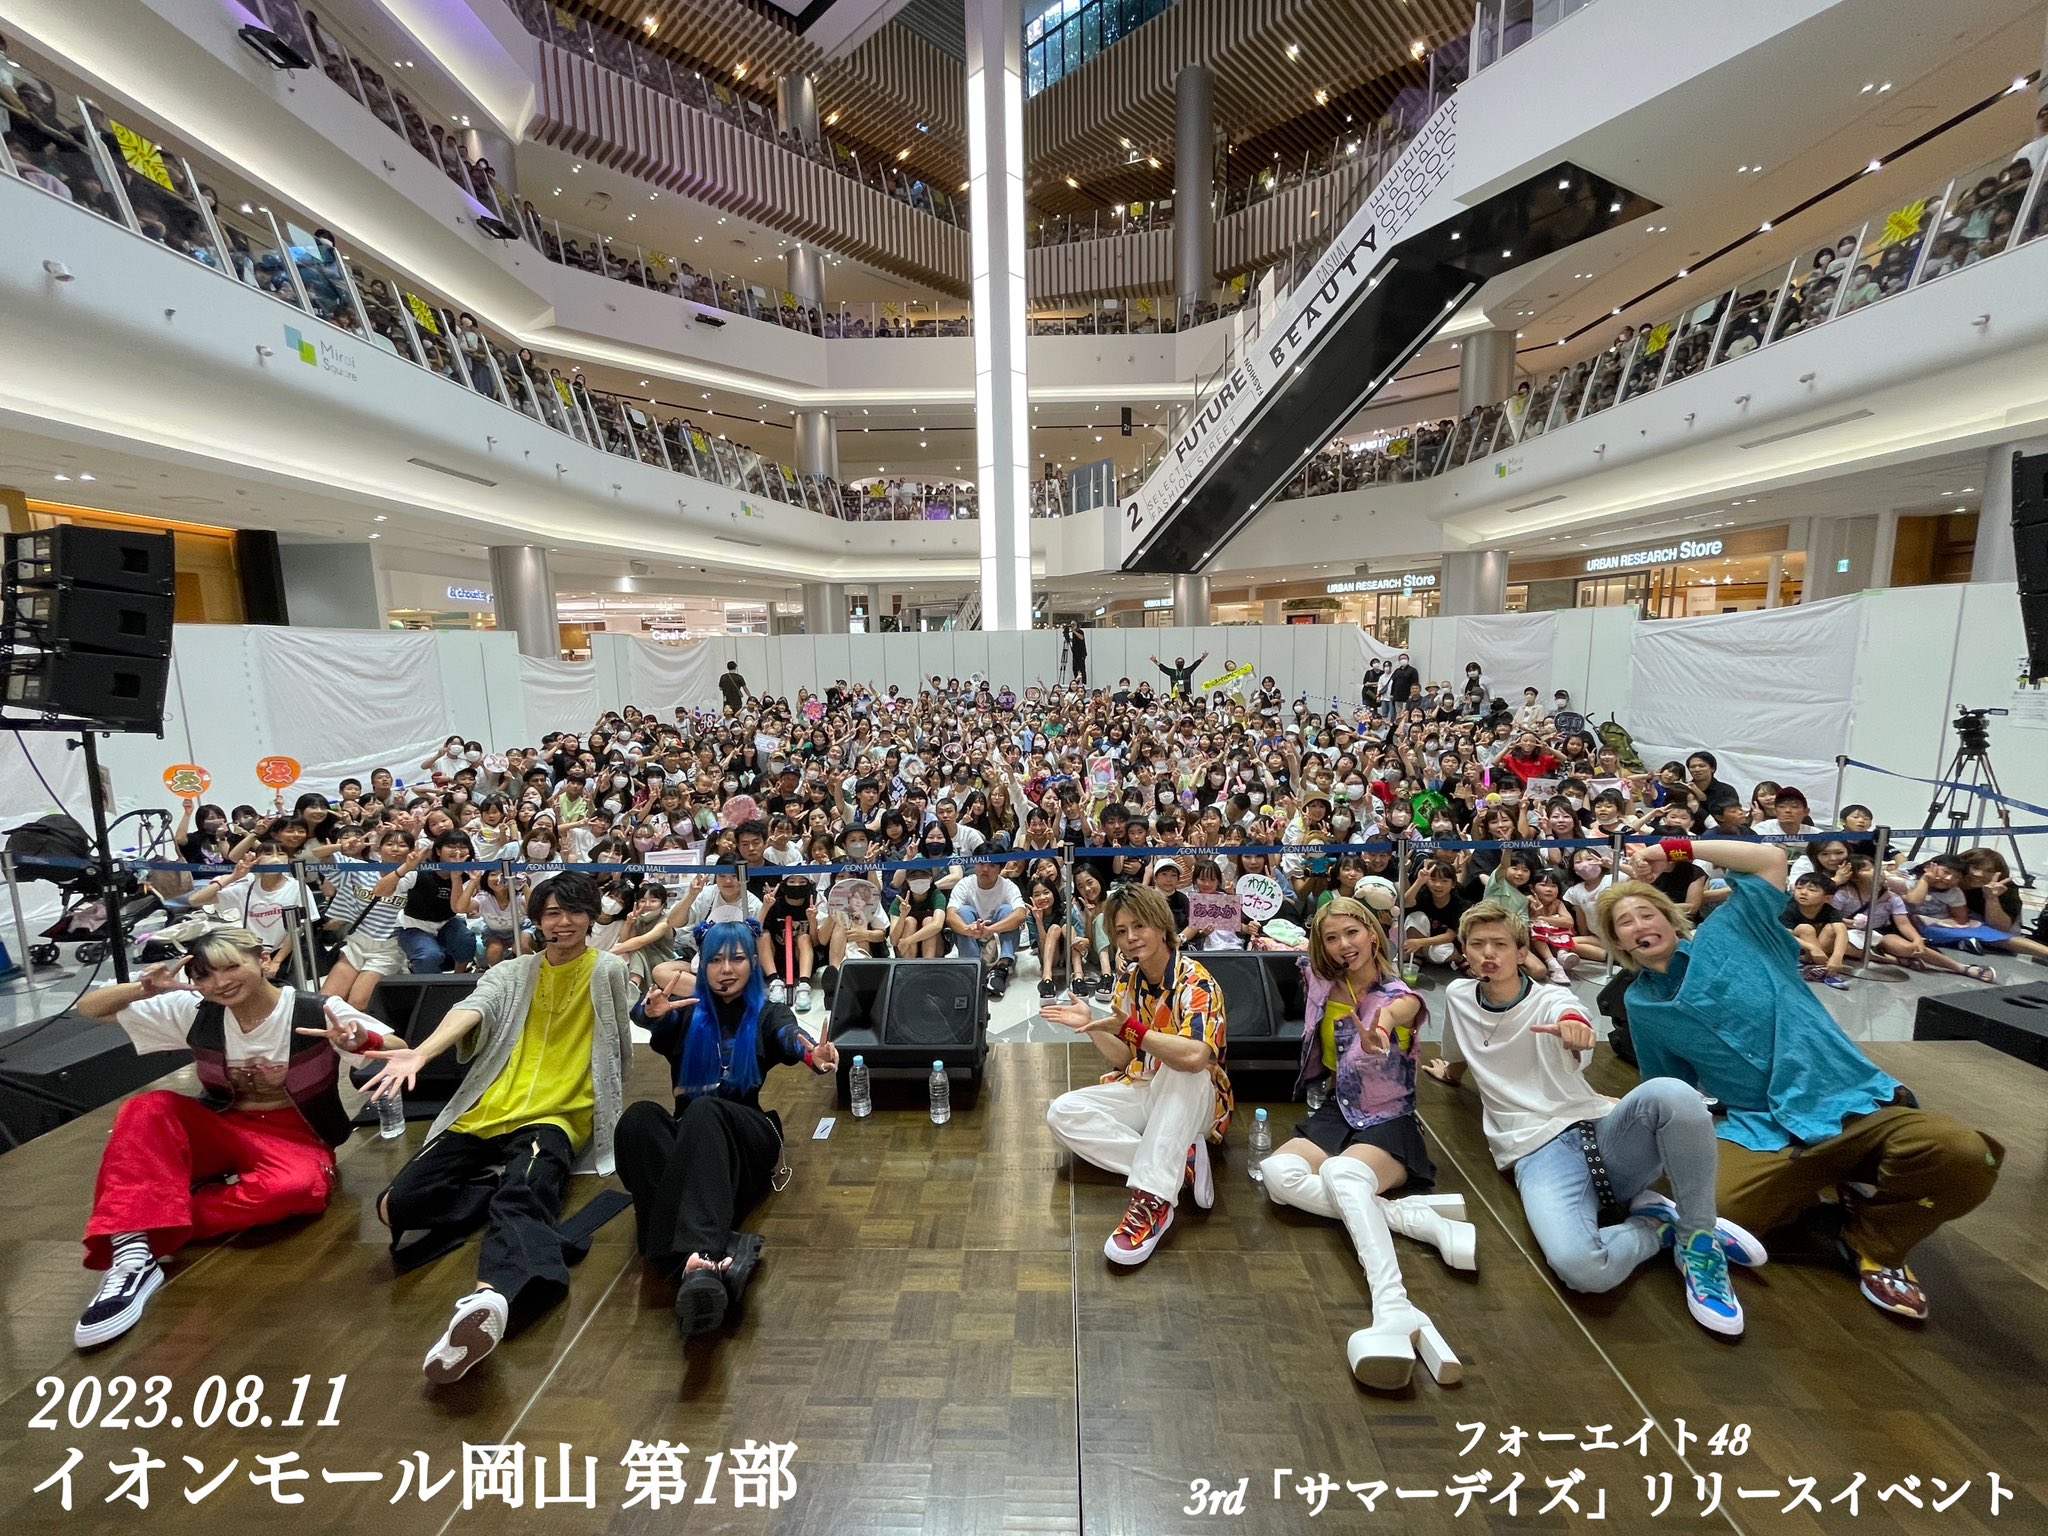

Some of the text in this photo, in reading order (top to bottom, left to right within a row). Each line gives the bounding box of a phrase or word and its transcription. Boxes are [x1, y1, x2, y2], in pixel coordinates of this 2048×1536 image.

[1316, 241, 1349, 285] CASUAL
[1269, 224, 1377, 368] BEAUTY
[320, 339, 356, 368] Mirai
[323, 357, 358, 381] Square
[1244, 357, 1264, 397] FASHION
[1175, 368, 1247, 463] FUTURE
[1151, 415, 1237, 523] FASHION STREET
[1147, 465, 1181, 511] SELECT
[1127, 501, 1143, 532] 2
[1586, 540, 1723, 571] URBAN RESEARCH Store
[1327, 574, 1436, 593] URBAN RESEARCH Store
[1521, 840, 1542, 848] MALL
[420, 863, 441, 871] MALL
[546, 863, 567, 871] MALL
[863, 863, 886, 871] MALL
[352, 884, 408, 907] NOTBLE
[1193, 902, 1237, 919] あみか
